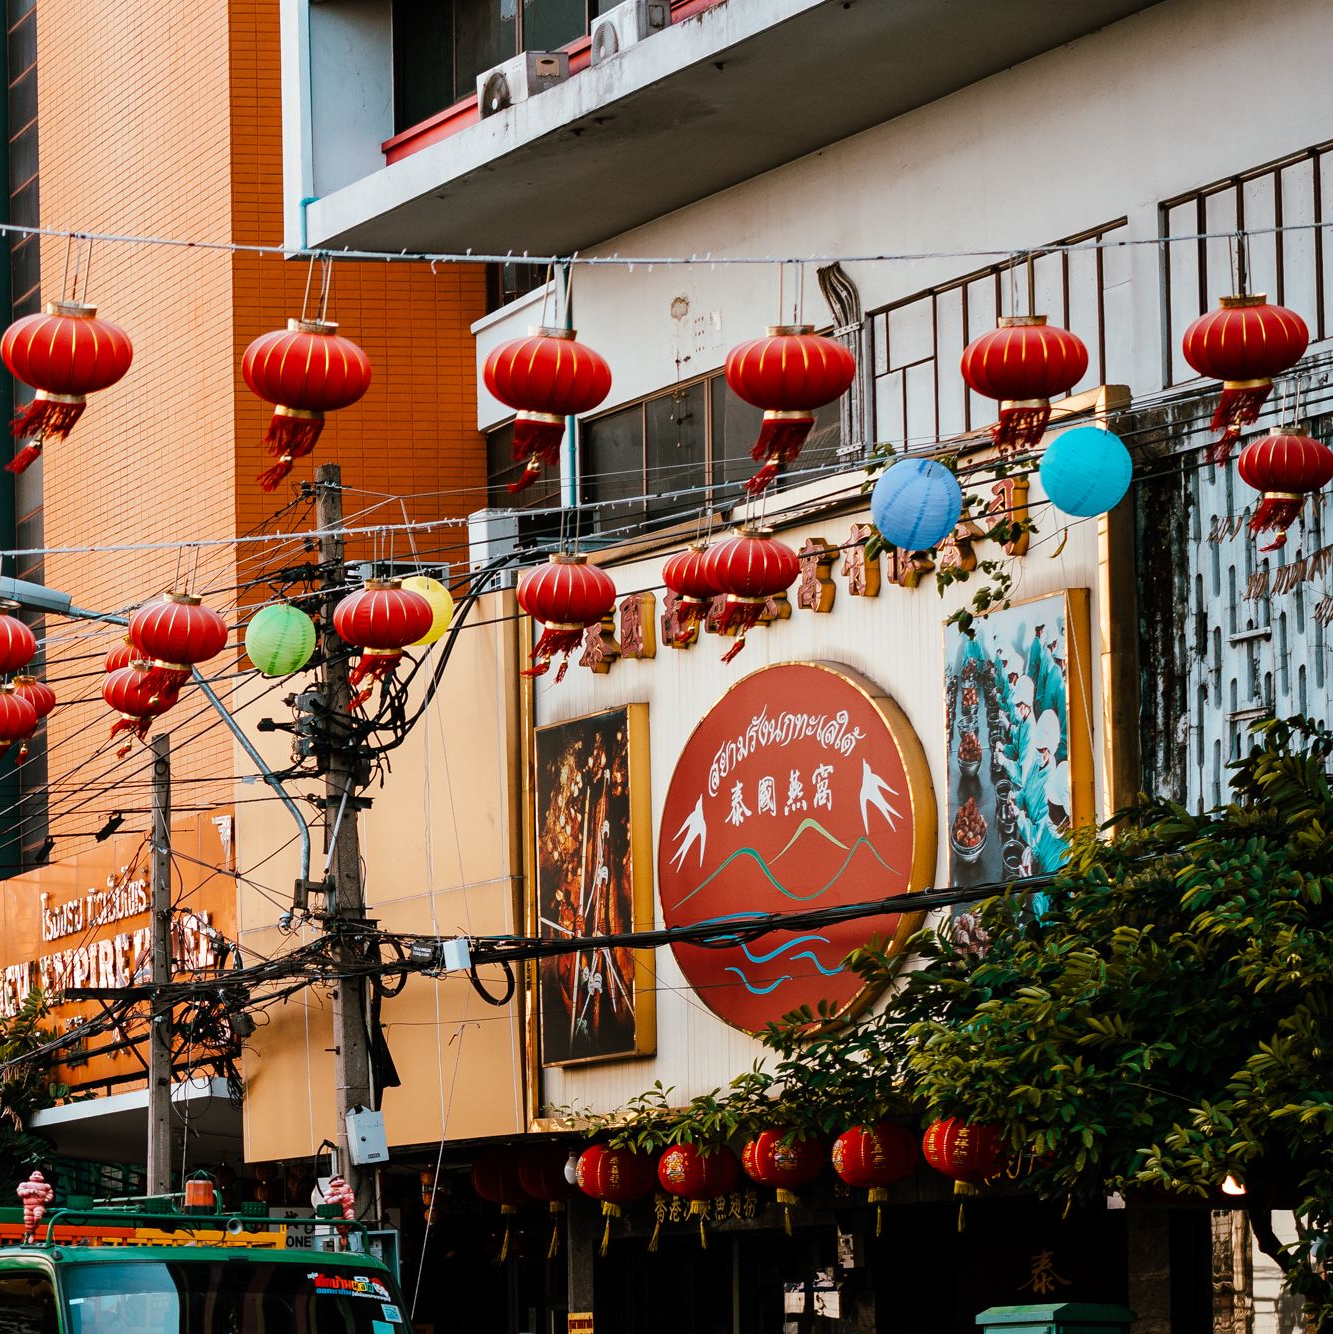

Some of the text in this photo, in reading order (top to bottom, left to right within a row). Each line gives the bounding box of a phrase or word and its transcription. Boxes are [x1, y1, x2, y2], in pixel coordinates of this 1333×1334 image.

[725, 763, 834, 826] 泰國燕窩
[133, 910, 220, 985] HTEL
